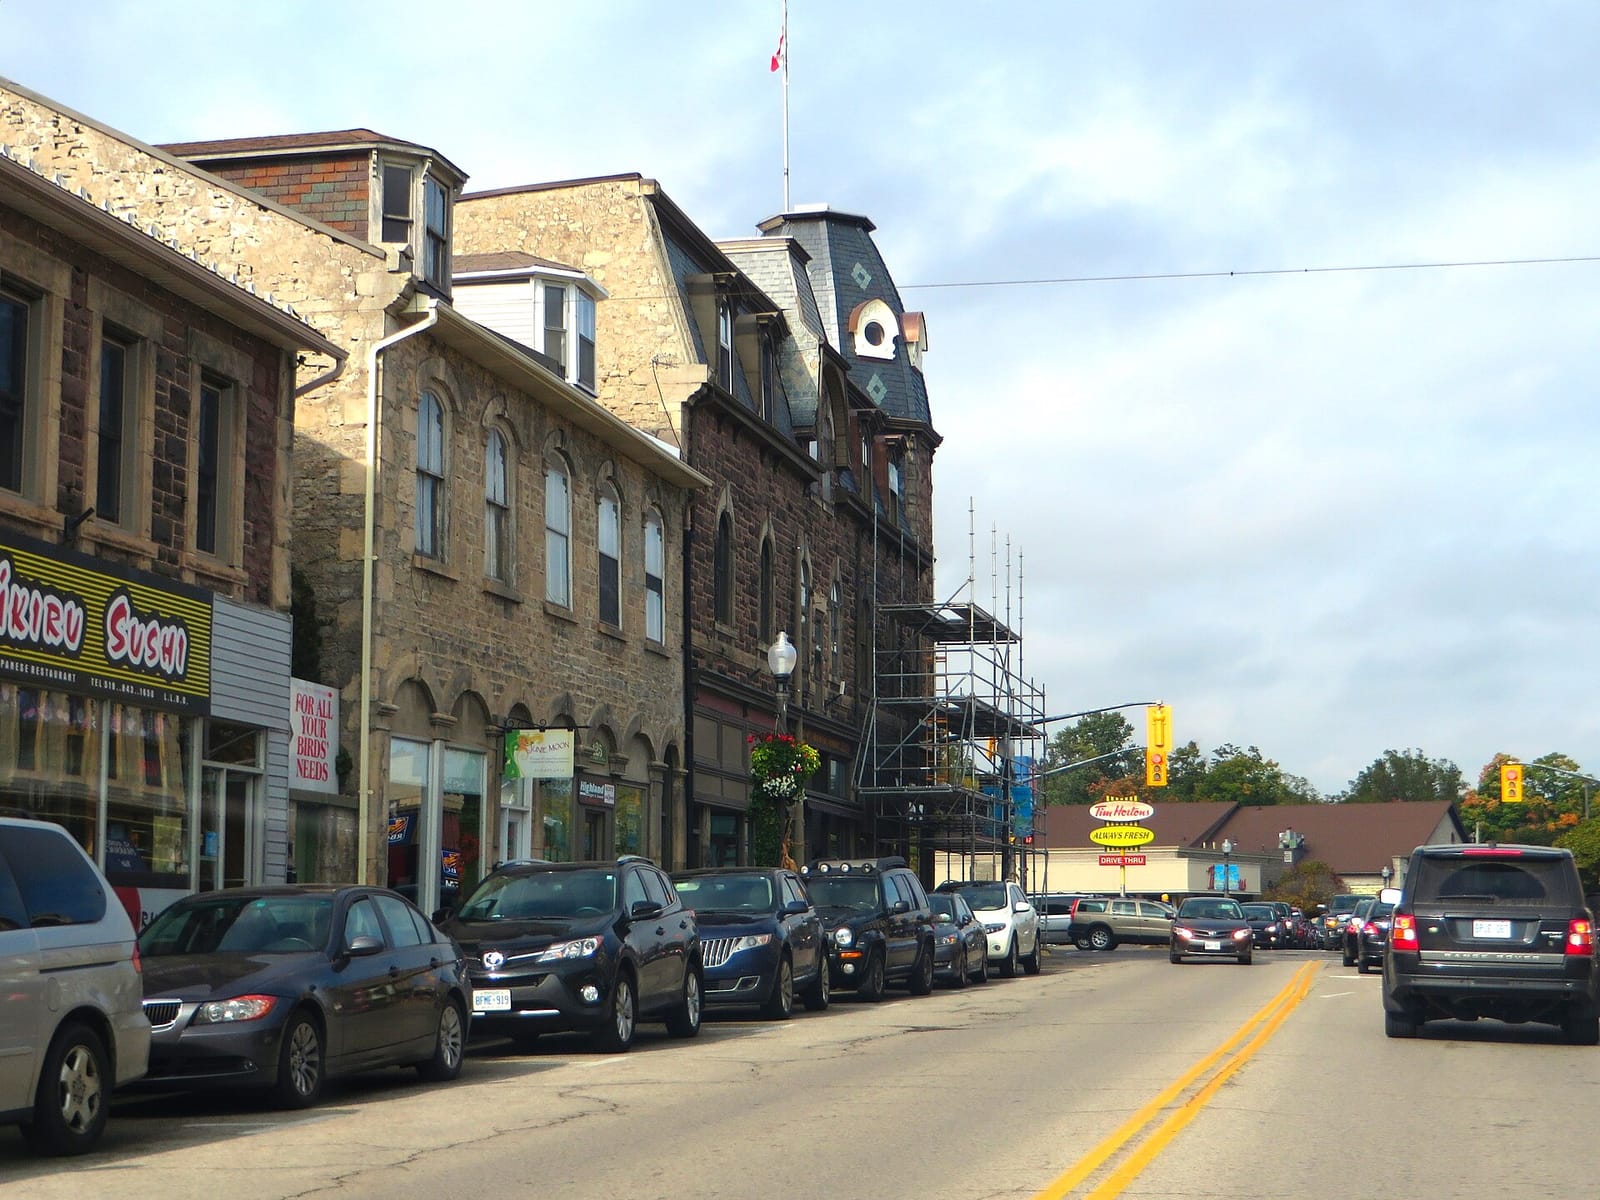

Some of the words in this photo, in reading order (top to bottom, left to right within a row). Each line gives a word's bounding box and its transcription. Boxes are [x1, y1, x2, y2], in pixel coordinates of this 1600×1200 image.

[31, 665, 76, 683] RESTAURANT
[295, 693, 314, 716] FOR
[316, 699, 334, 720] ALL
[301, 715, 327, 739] YOUR
[296, 758, 329, 782] NEEDS
[580, 781, 604, 794] Highland
[1094, 805, 1112, 817] Tim
[1113, 805, 1150, 817] Hortons
[1093, 831, 1122, 839] ALWAYS
[1124, 831, 1150, 839] FRESH
[495, 995, 509, 1005] 919
